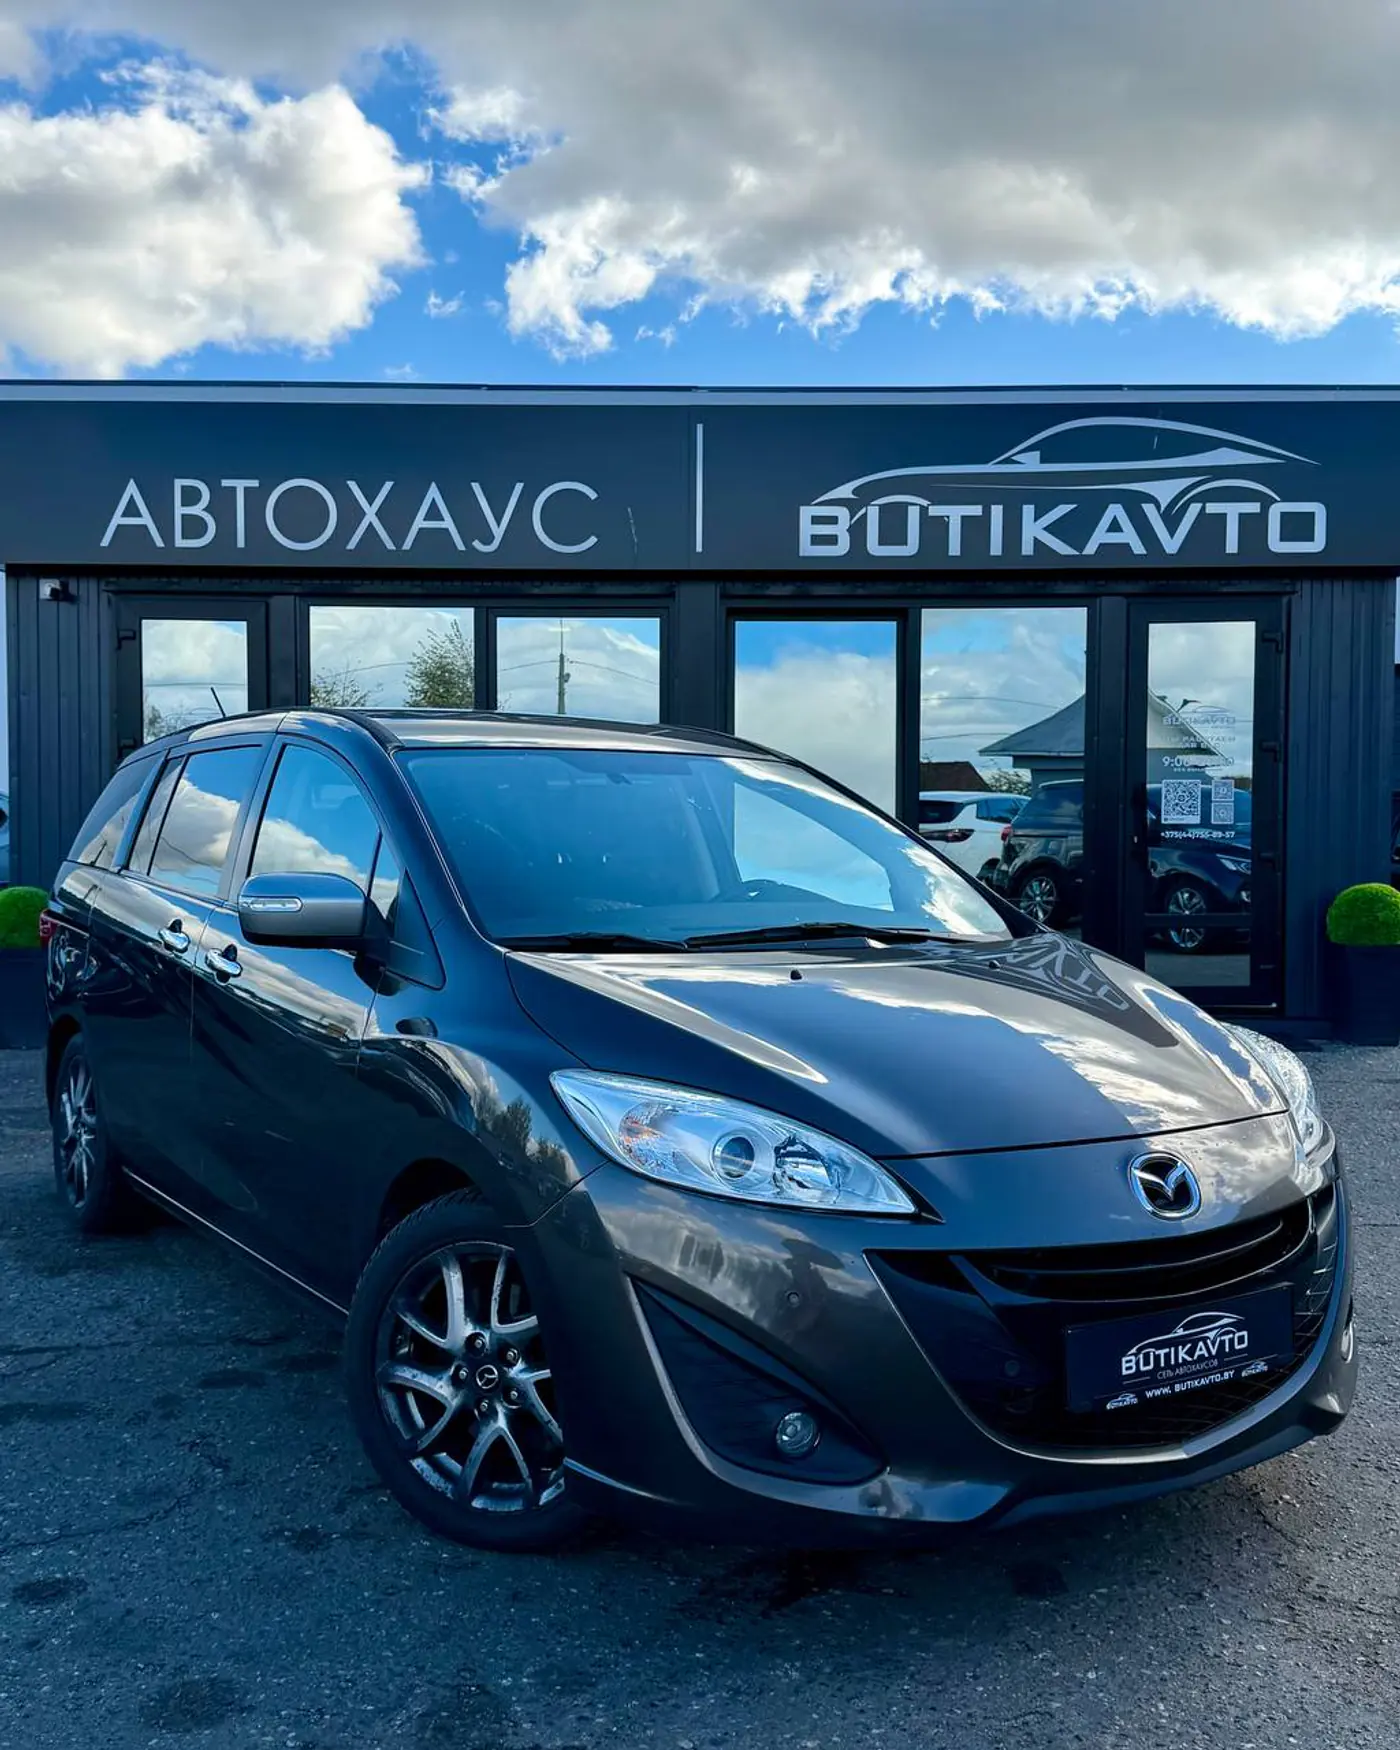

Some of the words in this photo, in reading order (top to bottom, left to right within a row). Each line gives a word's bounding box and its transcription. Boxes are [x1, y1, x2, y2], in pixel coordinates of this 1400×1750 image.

[100, 477, 600, 553] АВТОХАУС
[799, 499, 1326, 557] BUTIKAVTO
[1121, 1331, 1248, 1376] BUTIKAVTO
[1145, 1386, 1172, 1399] WWW.
[1174, 1369, 1235, 1393] BUTIKAVTO.BY
